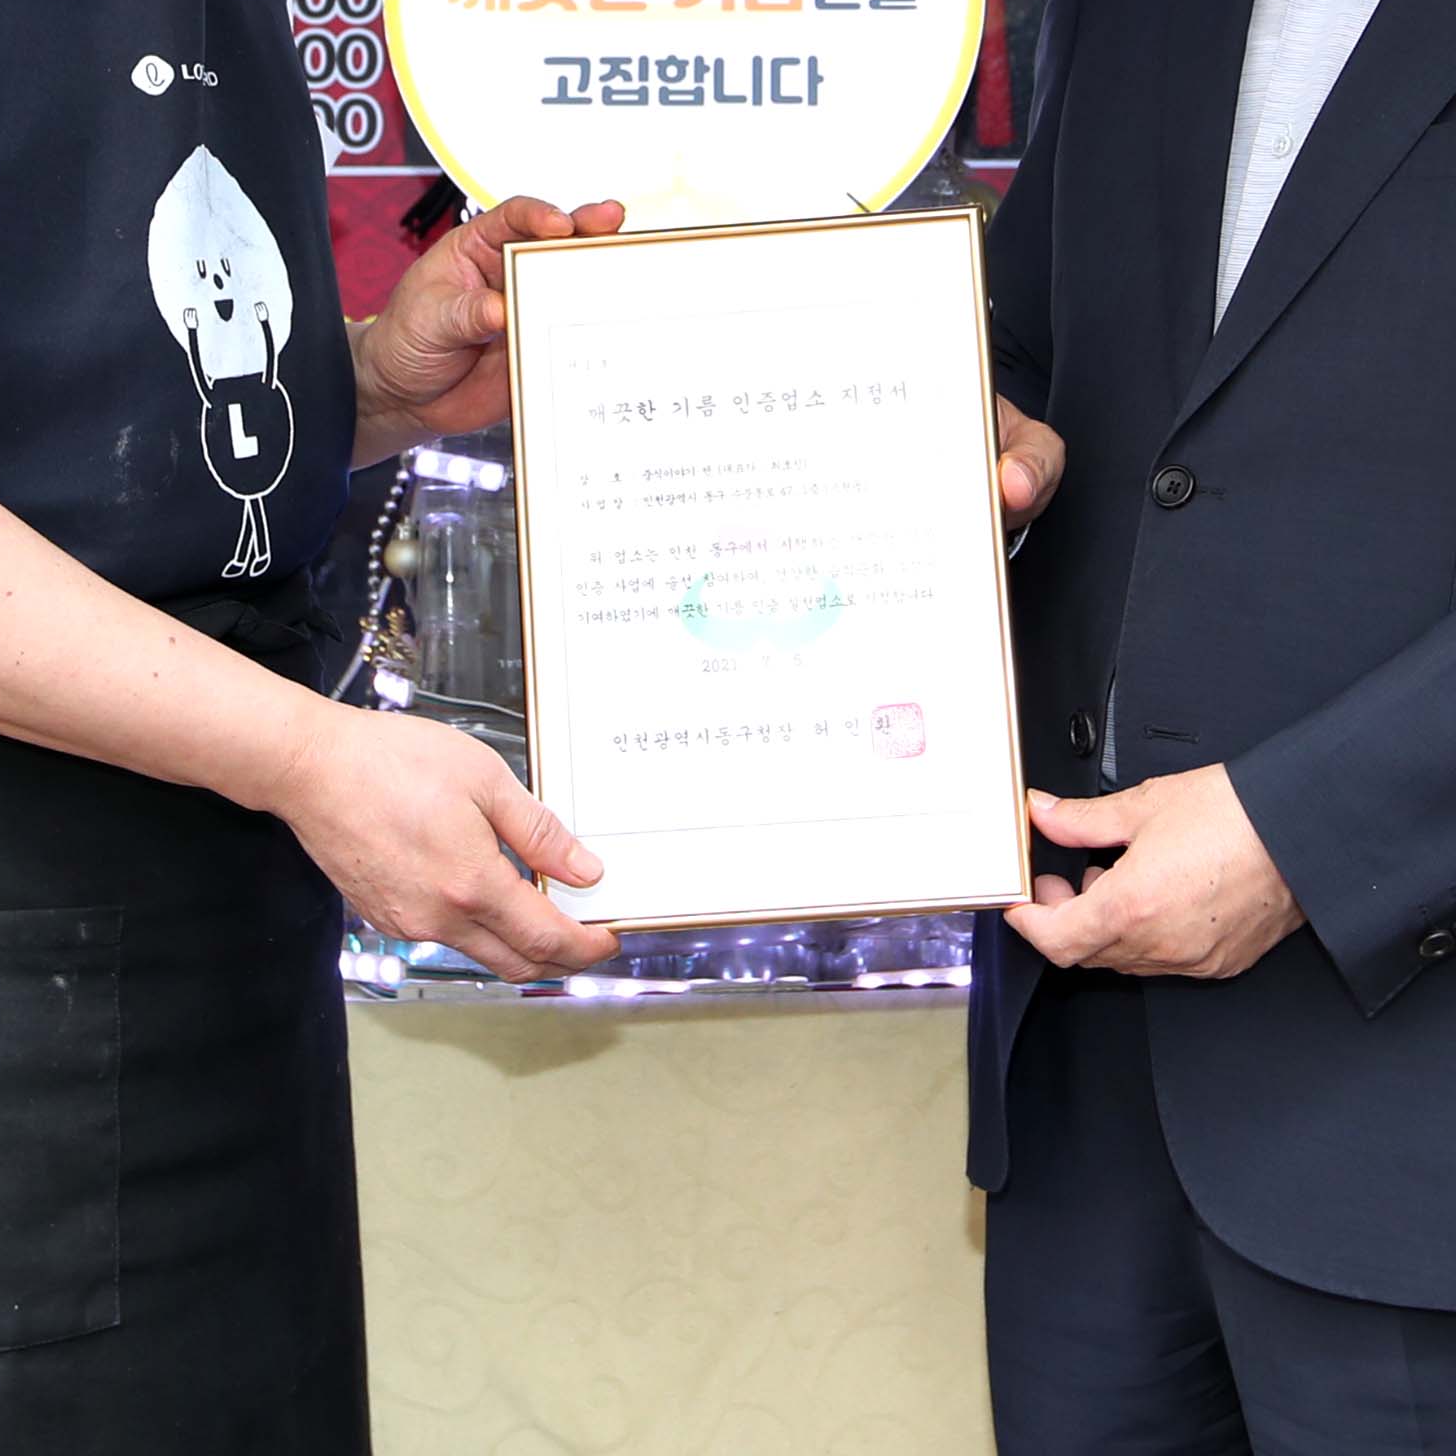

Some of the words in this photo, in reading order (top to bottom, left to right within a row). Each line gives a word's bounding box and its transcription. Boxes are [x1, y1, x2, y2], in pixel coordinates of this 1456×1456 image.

[541, 54, 825, 107] 고집합니다
[228, 403, 258, 458] L
[587, 400, 657, 425] 깨끗한
[671, 393, 718, 419] 기름
[732, 388, 826, 415] 인증업소
